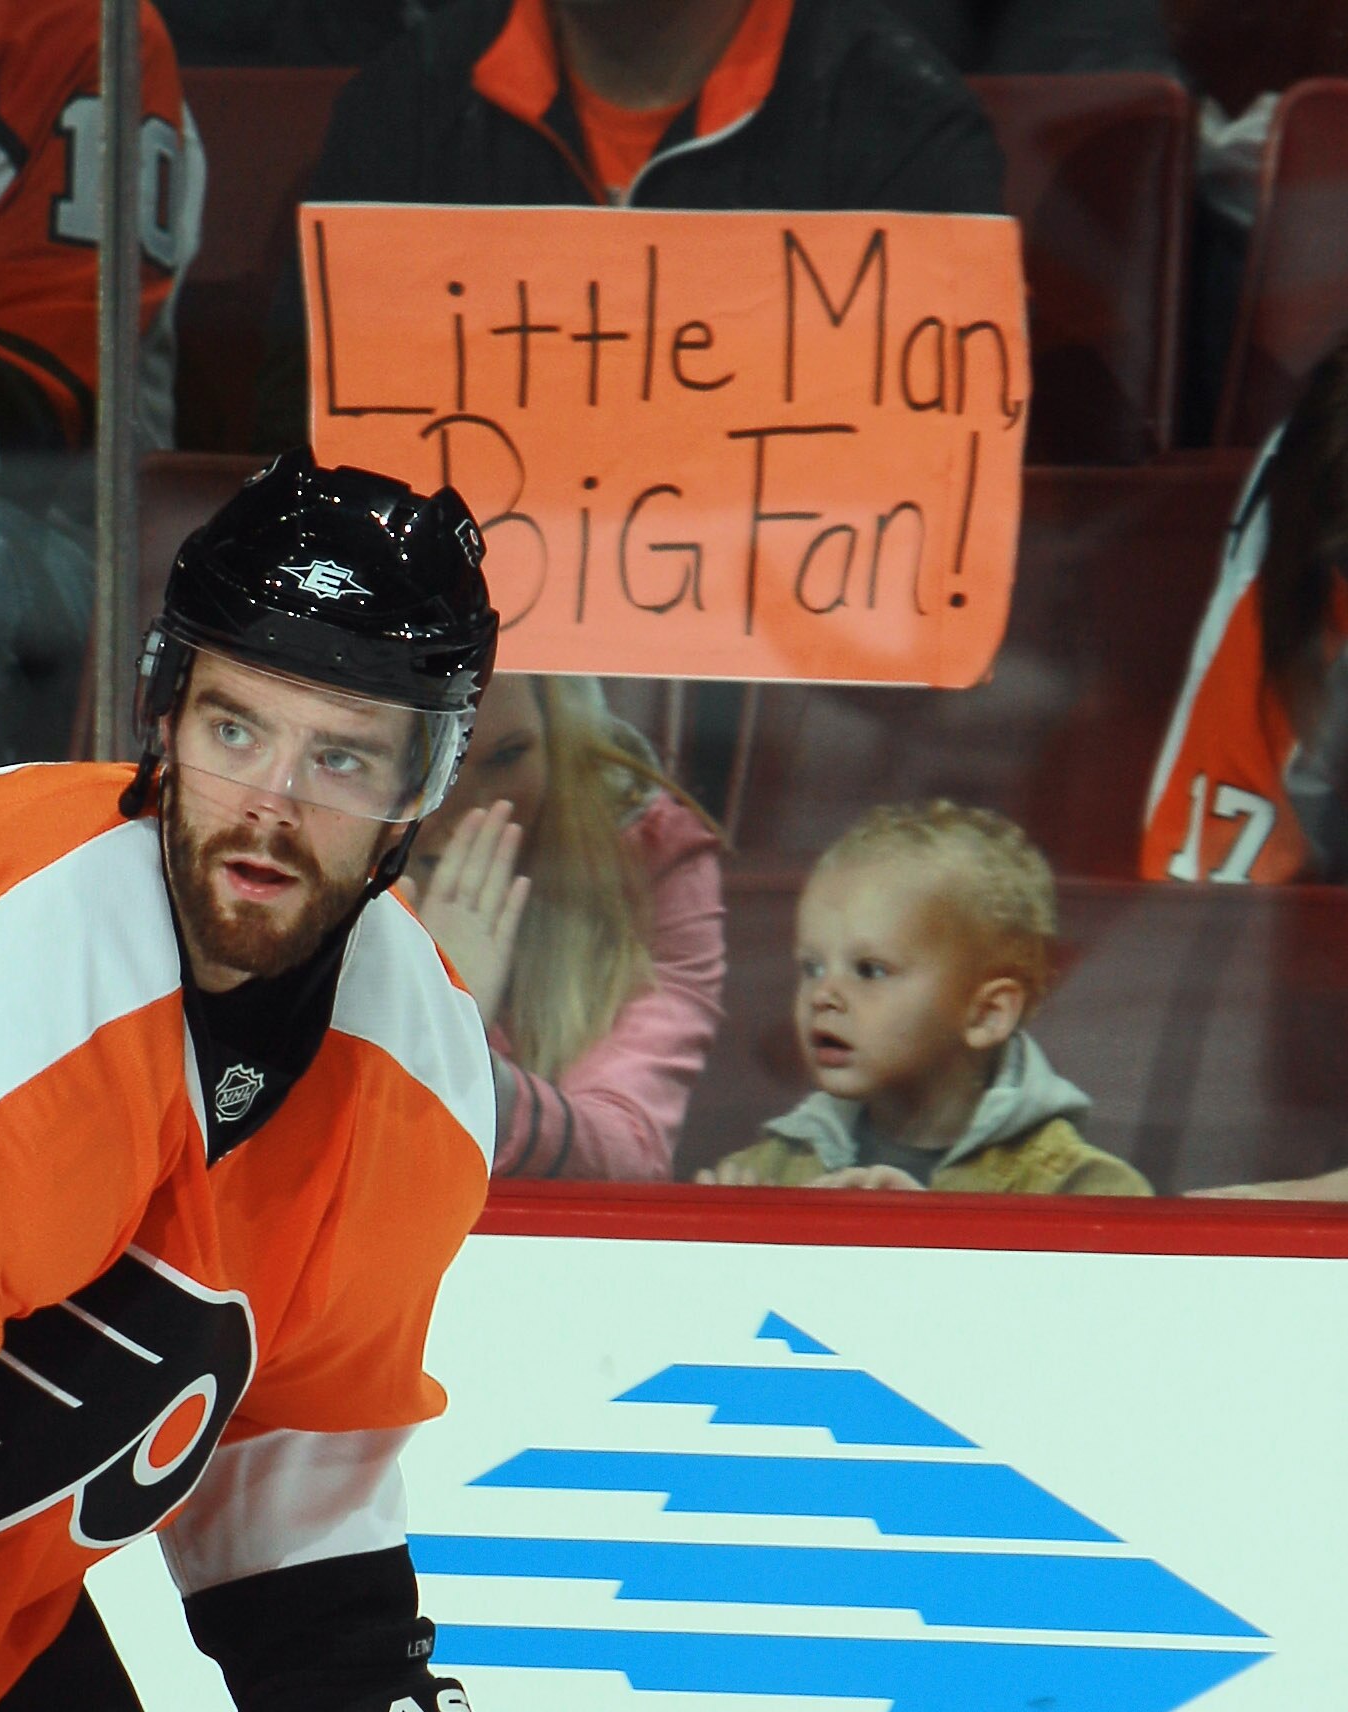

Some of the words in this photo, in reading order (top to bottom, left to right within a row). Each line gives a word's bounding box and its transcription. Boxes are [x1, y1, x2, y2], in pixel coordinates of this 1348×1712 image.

[50, 92, 184, 274] 10
[314, 219, 736, 417] Little
[781, 228, 1024, 431] Man,
[727, 424, 982, 637] Fan!
[1167, 773, 1277, 885] 17
